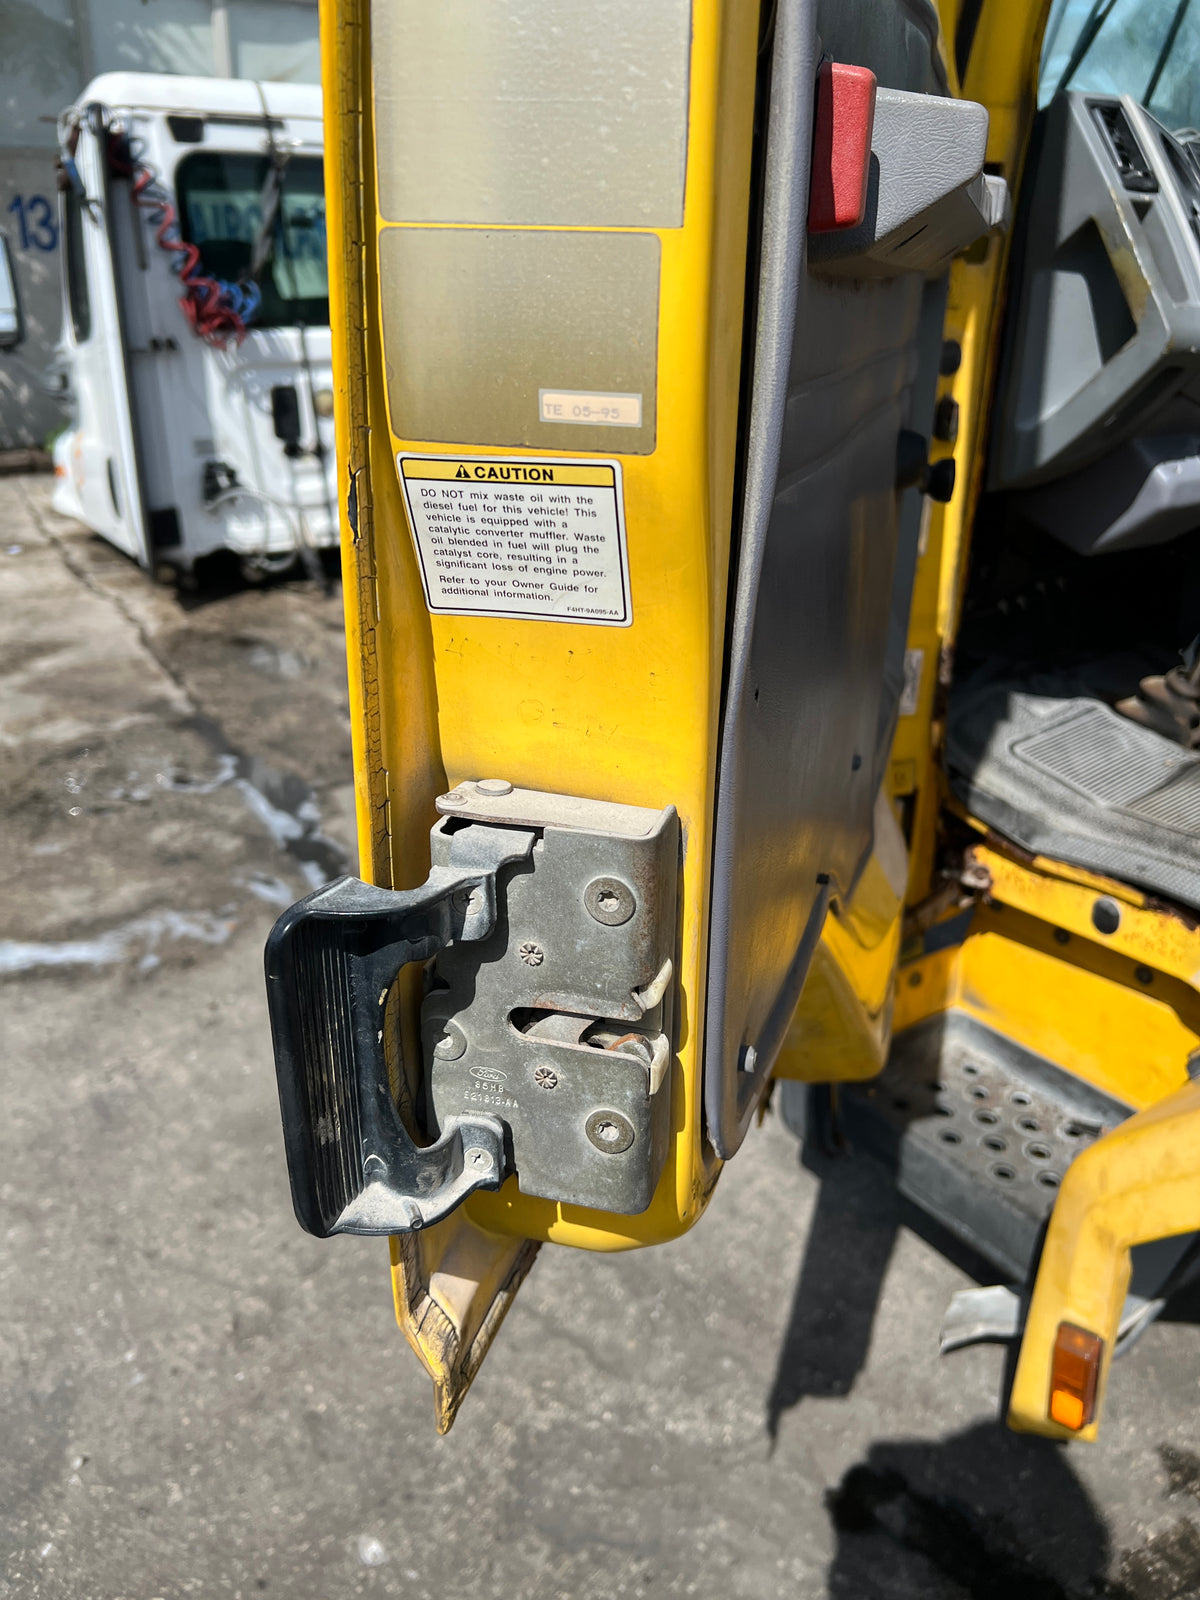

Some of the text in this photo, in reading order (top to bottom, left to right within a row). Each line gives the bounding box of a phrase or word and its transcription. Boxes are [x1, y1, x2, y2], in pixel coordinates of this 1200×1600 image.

[9, 194, 58, 251] 13
[544, 403, 620, 420] TE 05-95
[473, 466, 554, 480] CAUTION
[420, 488, 436, 497] DO
[441, 489, 464, 498] NOT
[530, 494, 543, 502] oil
[548, 494, 570, 503] with
[576, 496, 593, 504] the
[423, 501, 597, 517] diesel fuel for this vehicle! This
[425, 513, 461, 521] vehicle
[480, 516, 529, 527] equipped
[534, 519, 556, 527] with
[427, 525, 605, 542] catalytic converter muffler. Waste
[447, 538, 488, 547] blended
[507, 541, 527, 549] fuel
[531, 542, 549, 550] will
[554, 544, 578, 554] plug
[433, 548, 472, 558] catalyst
[507, 553, 552, 563] resulting
[435, 560, 487, 570] significant
[492, 563, 513, 571] loss
[533, 566, 567, 576] engine
[572, 570, 606, 578] power.
[438, 575, 464, 583] Refer
[484, 579, 506, 588] your
[512, 580, 544, 589] Owner
[549, 583, 579, 591] Guide
[584, 585, 598, 593] for
[441, 587, 553, 600] additional information.
